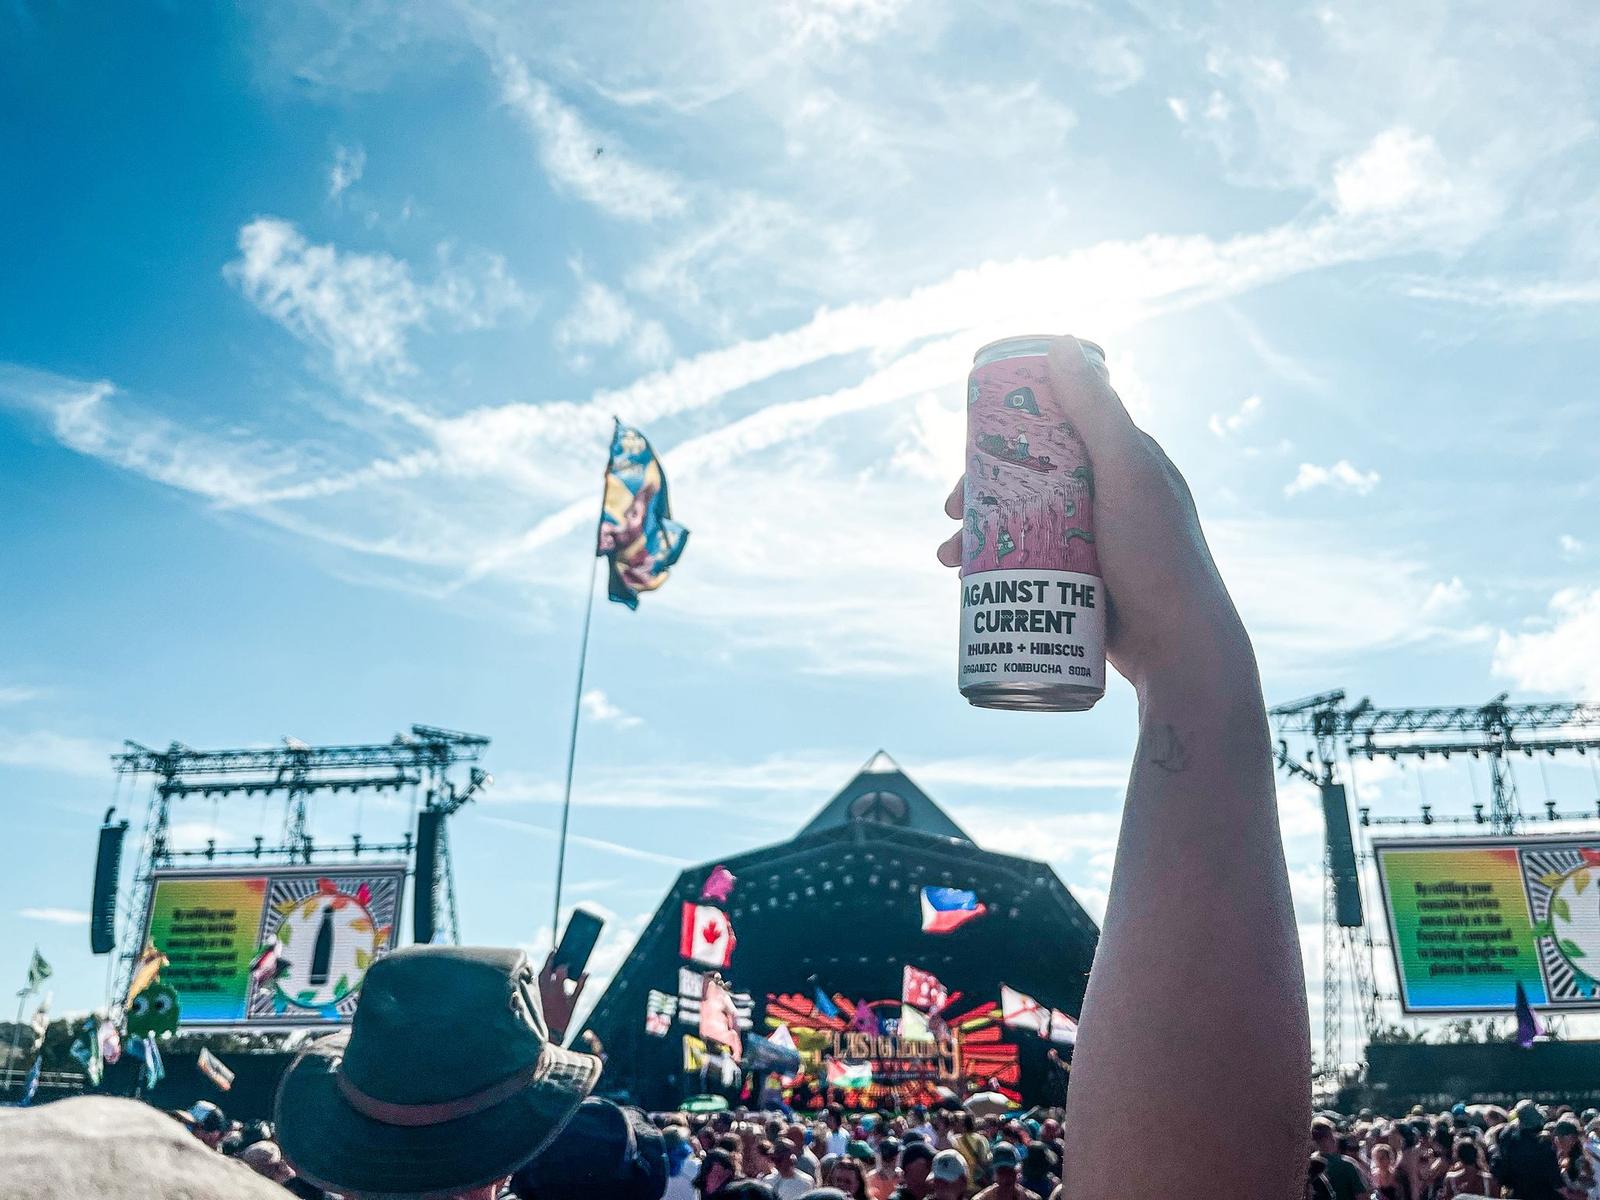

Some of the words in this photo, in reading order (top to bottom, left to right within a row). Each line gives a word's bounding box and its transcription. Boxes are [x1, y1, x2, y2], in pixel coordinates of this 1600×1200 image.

[963, 580, 1049, 608] AGAINST
[1057, 581, 1095, 608] THE
[974, 609, 1076, 635] CURRENT
[967, 641, 1013, 656] RHUBARB
[1030, 642, 1085, 658] HIBISCUS
[963, 662, 997, 675] ORGANIC
[1003, 662, 1062, 674] KOMBUCHA
[1068, 665, 1092, 677] SODA
